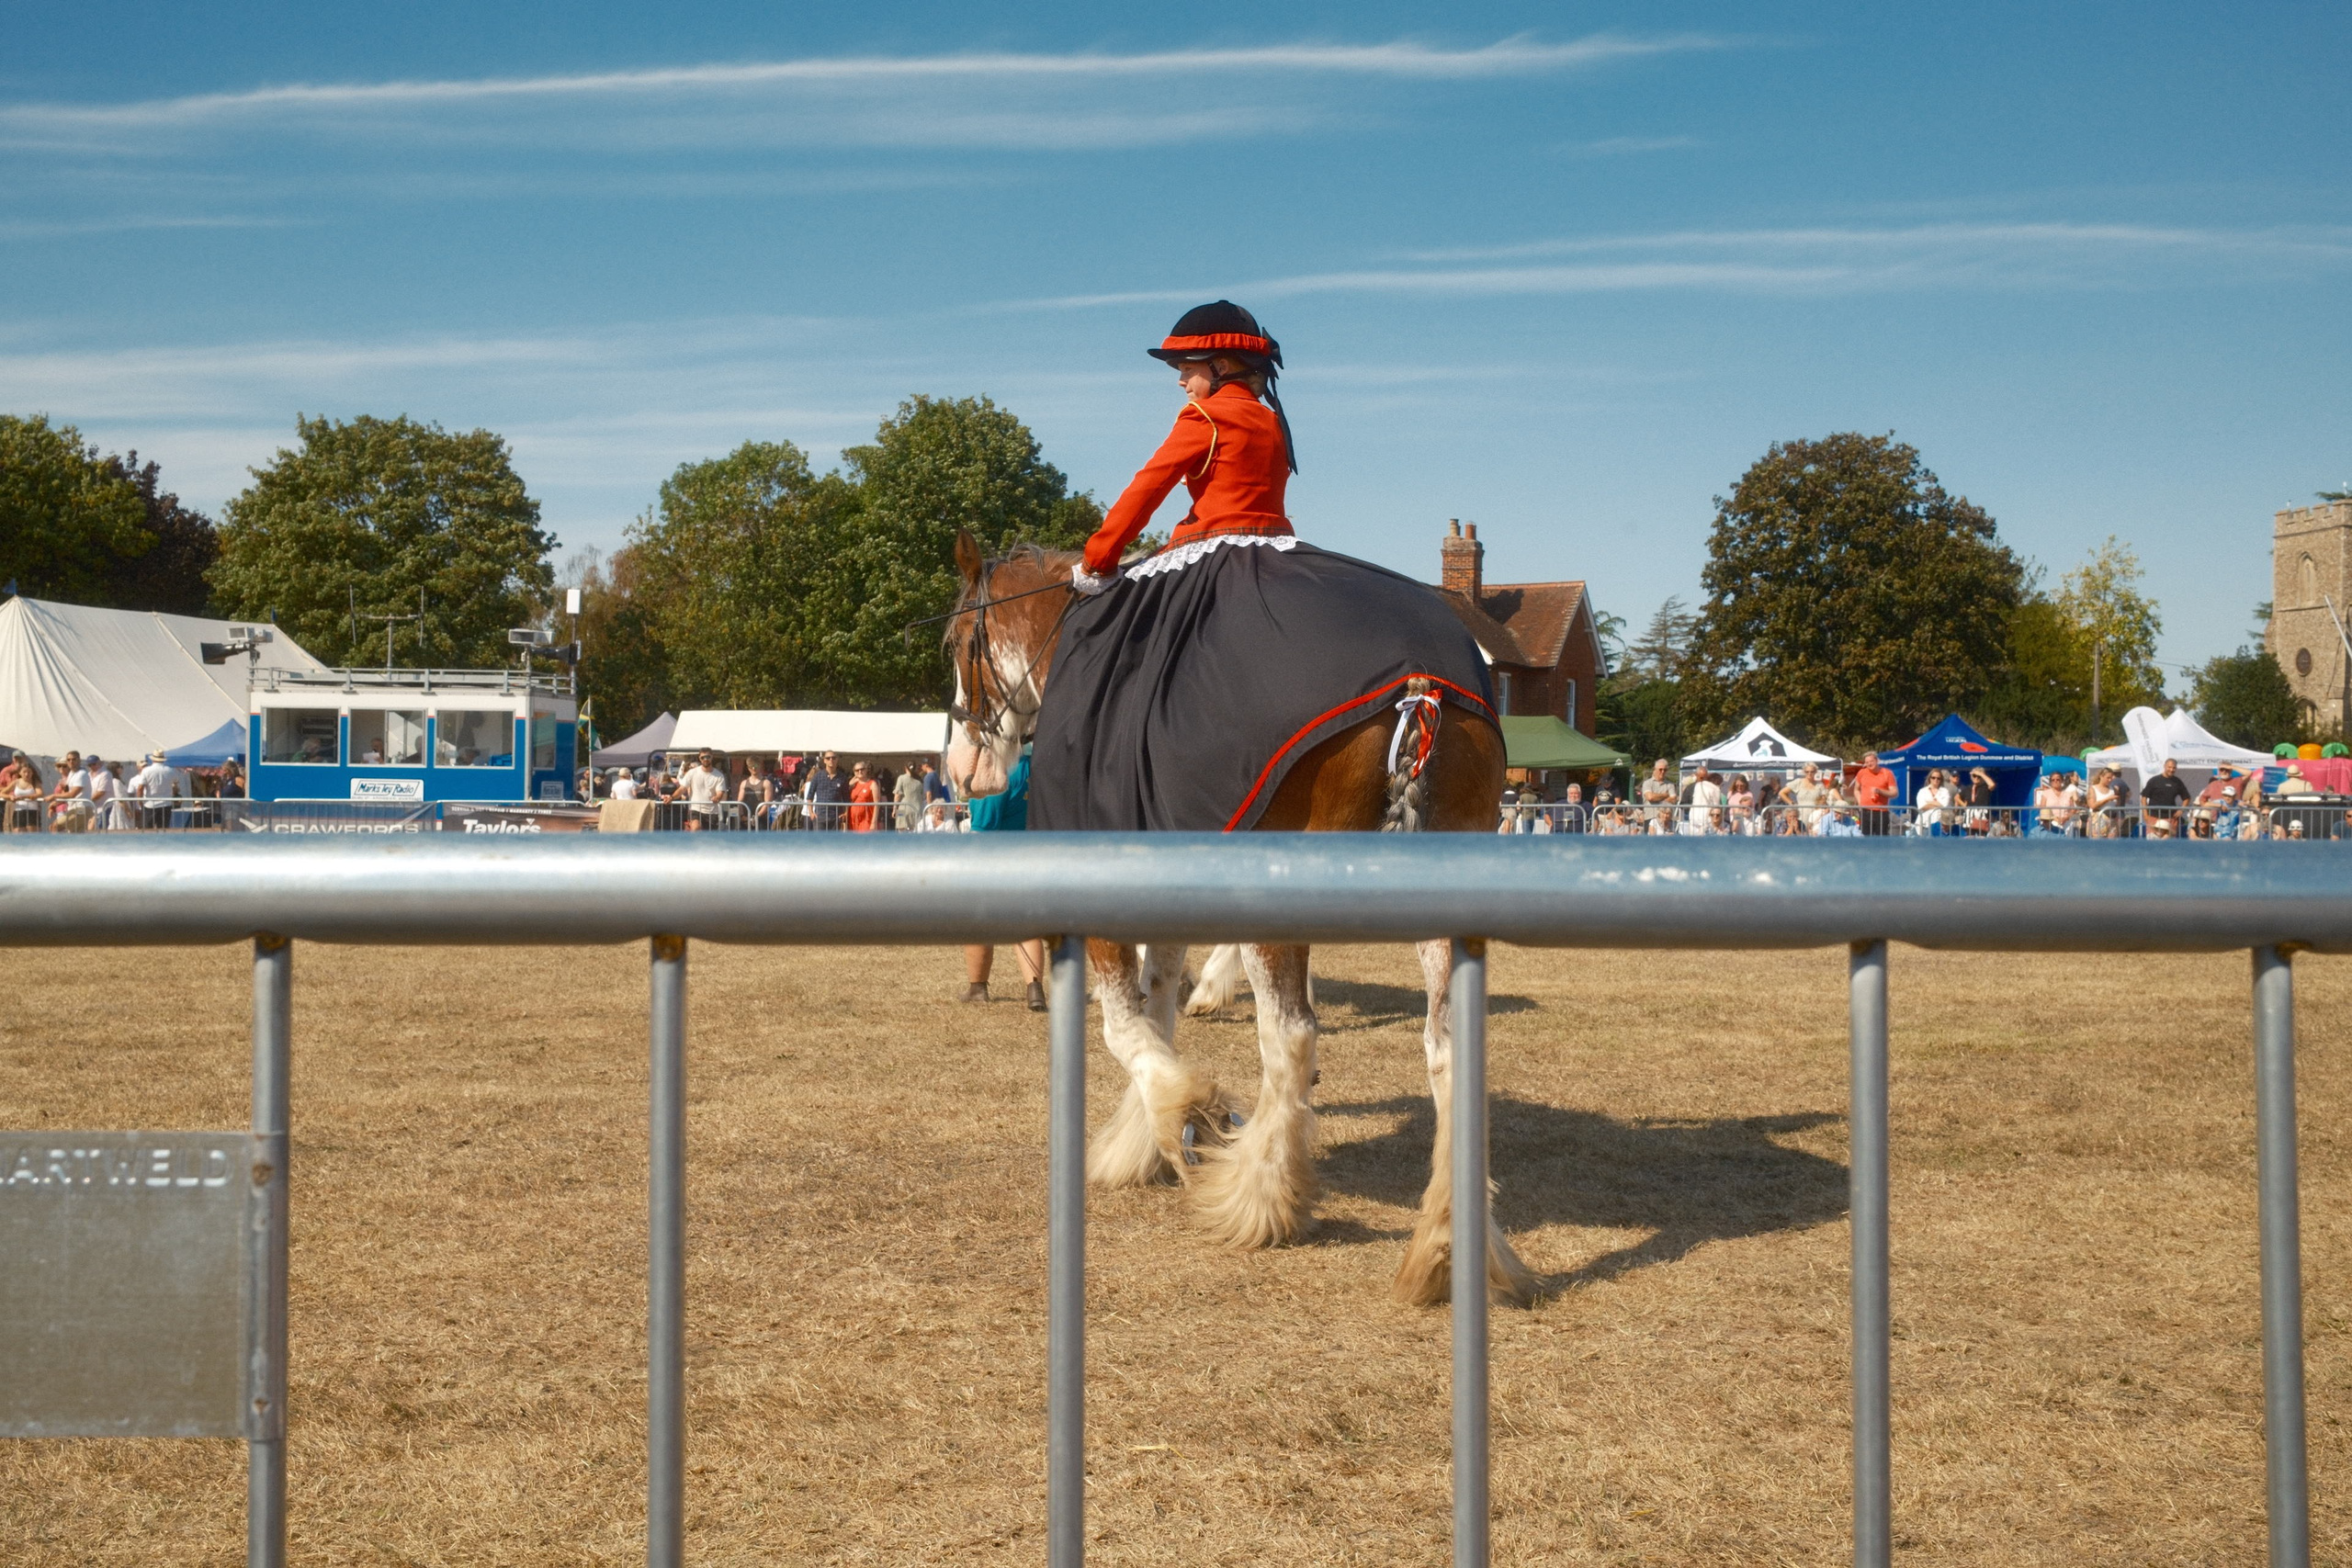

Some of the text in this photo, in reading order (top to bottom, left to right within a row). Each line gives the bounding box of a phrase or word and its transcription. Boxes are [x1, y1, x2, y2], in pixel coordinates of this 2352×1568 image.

[358, 783, 414, 794] Marks Tey Radio
[0, 1148, 233, 1187] ARTWELD
